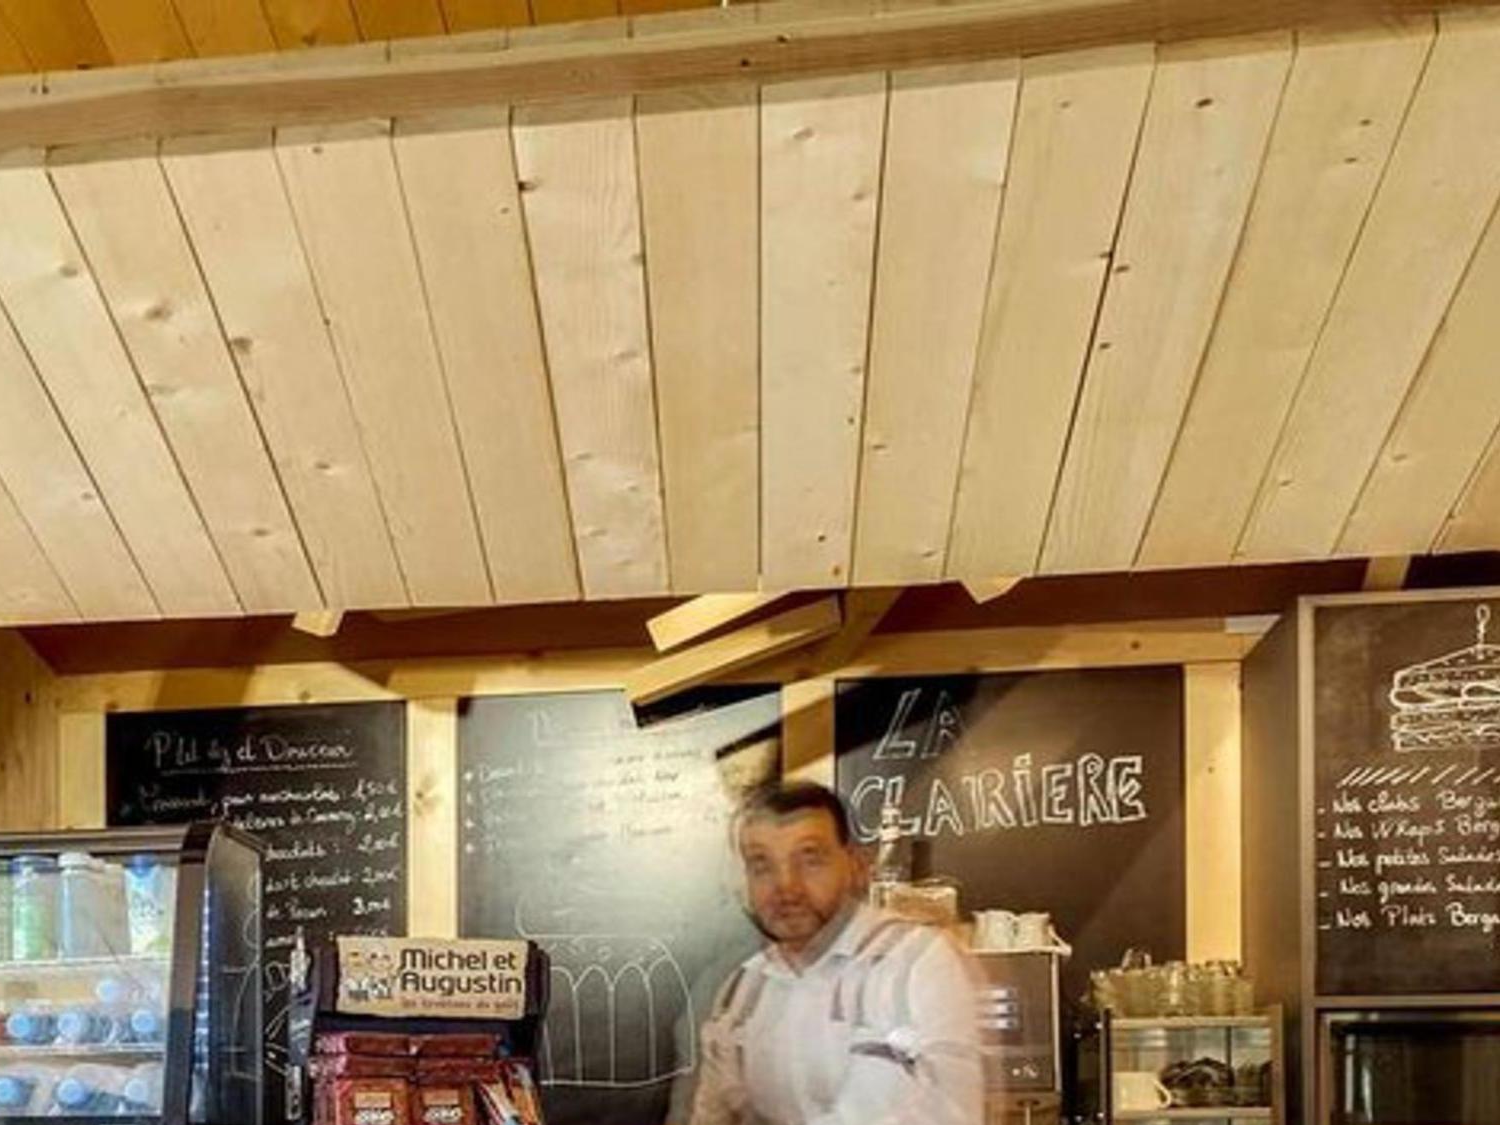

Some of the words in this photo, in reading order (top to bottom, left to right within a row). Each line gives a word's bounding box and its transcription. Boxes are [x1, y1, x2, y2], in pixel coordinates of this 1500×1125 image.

[872, 687, 964, 760] LA
[402, 948, 487, 970] Michel
[493, 951, 517, 970] et
[402, 971, 523, 997] Augustin
